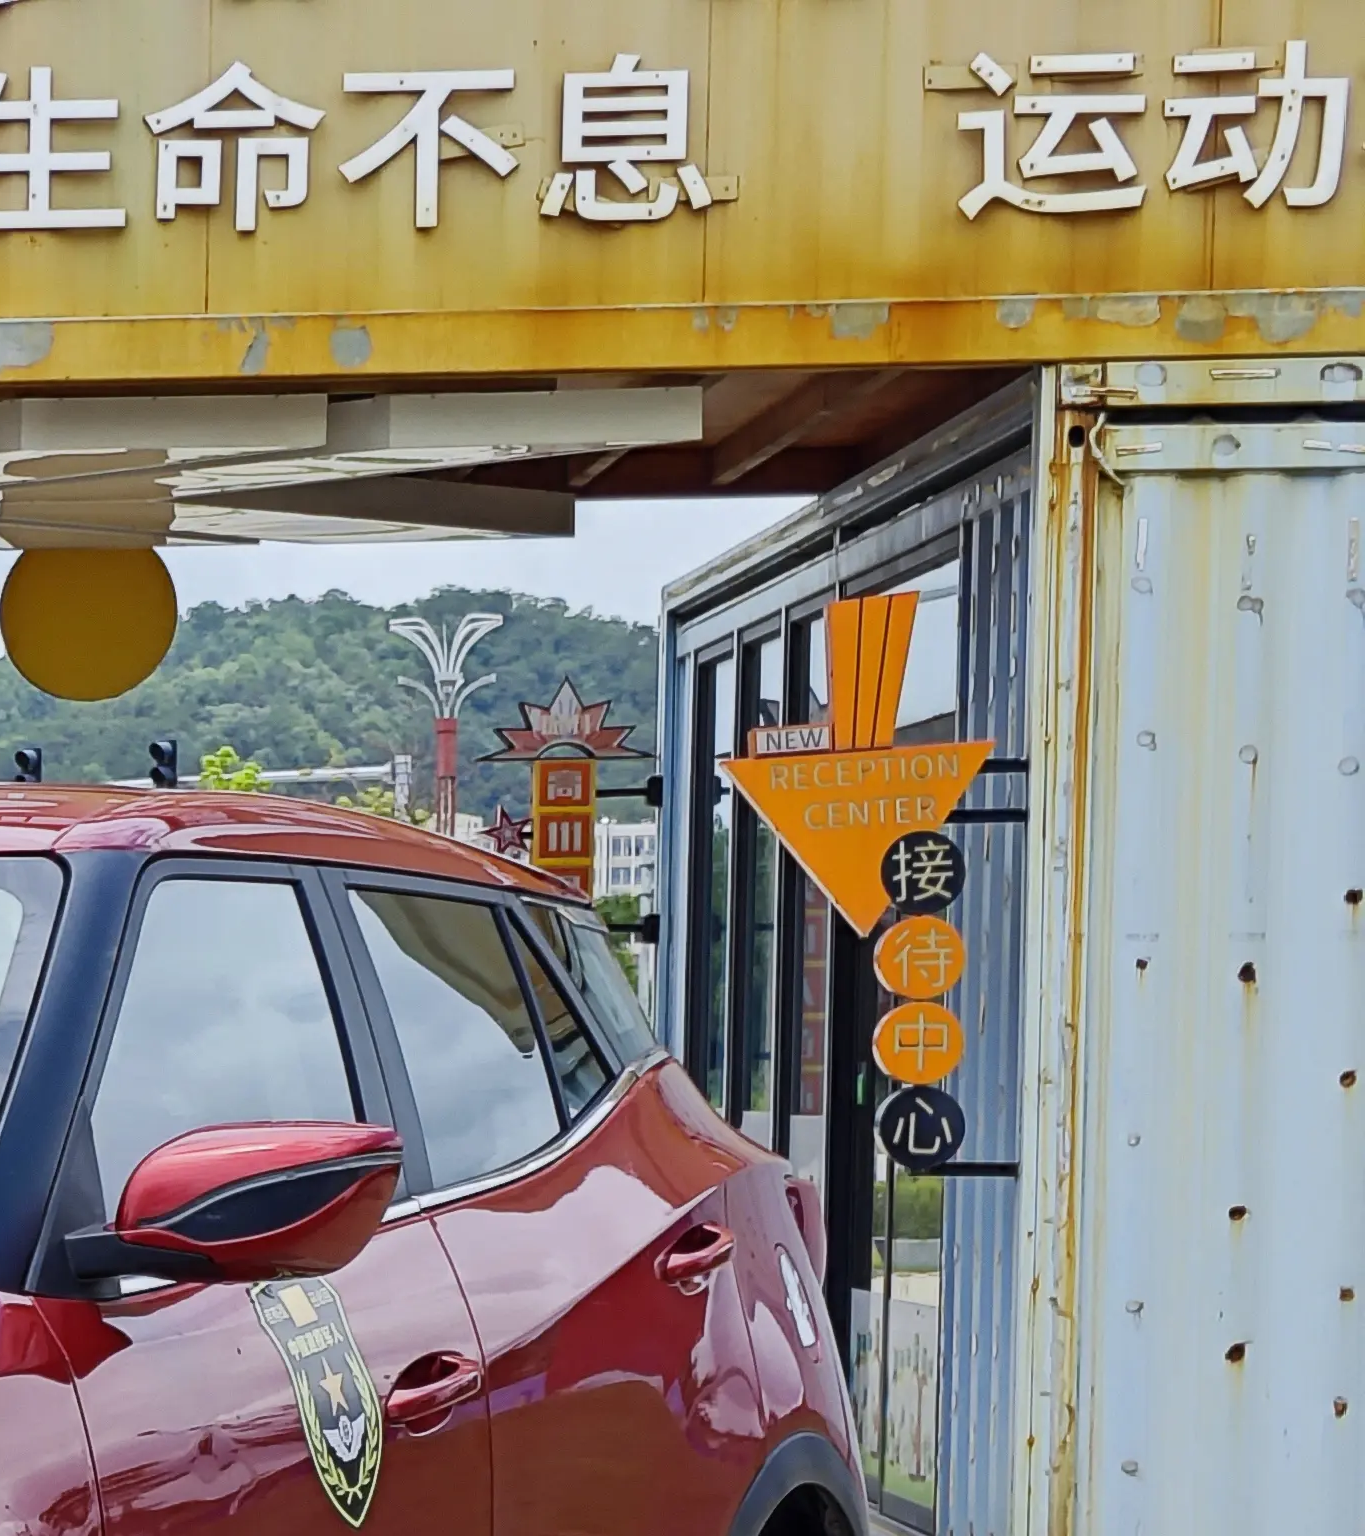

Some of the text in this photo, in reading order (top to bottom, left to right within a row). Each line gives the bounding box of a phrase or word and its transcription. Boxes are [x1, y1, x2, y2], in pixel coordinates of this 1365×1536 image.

[765, 728, 823, 751] NEW
[770, 752, 960, 792] RECEPTION
[803, 796, 937, 831] CENTER
[891, 840, 954, 1157] 接待中心
